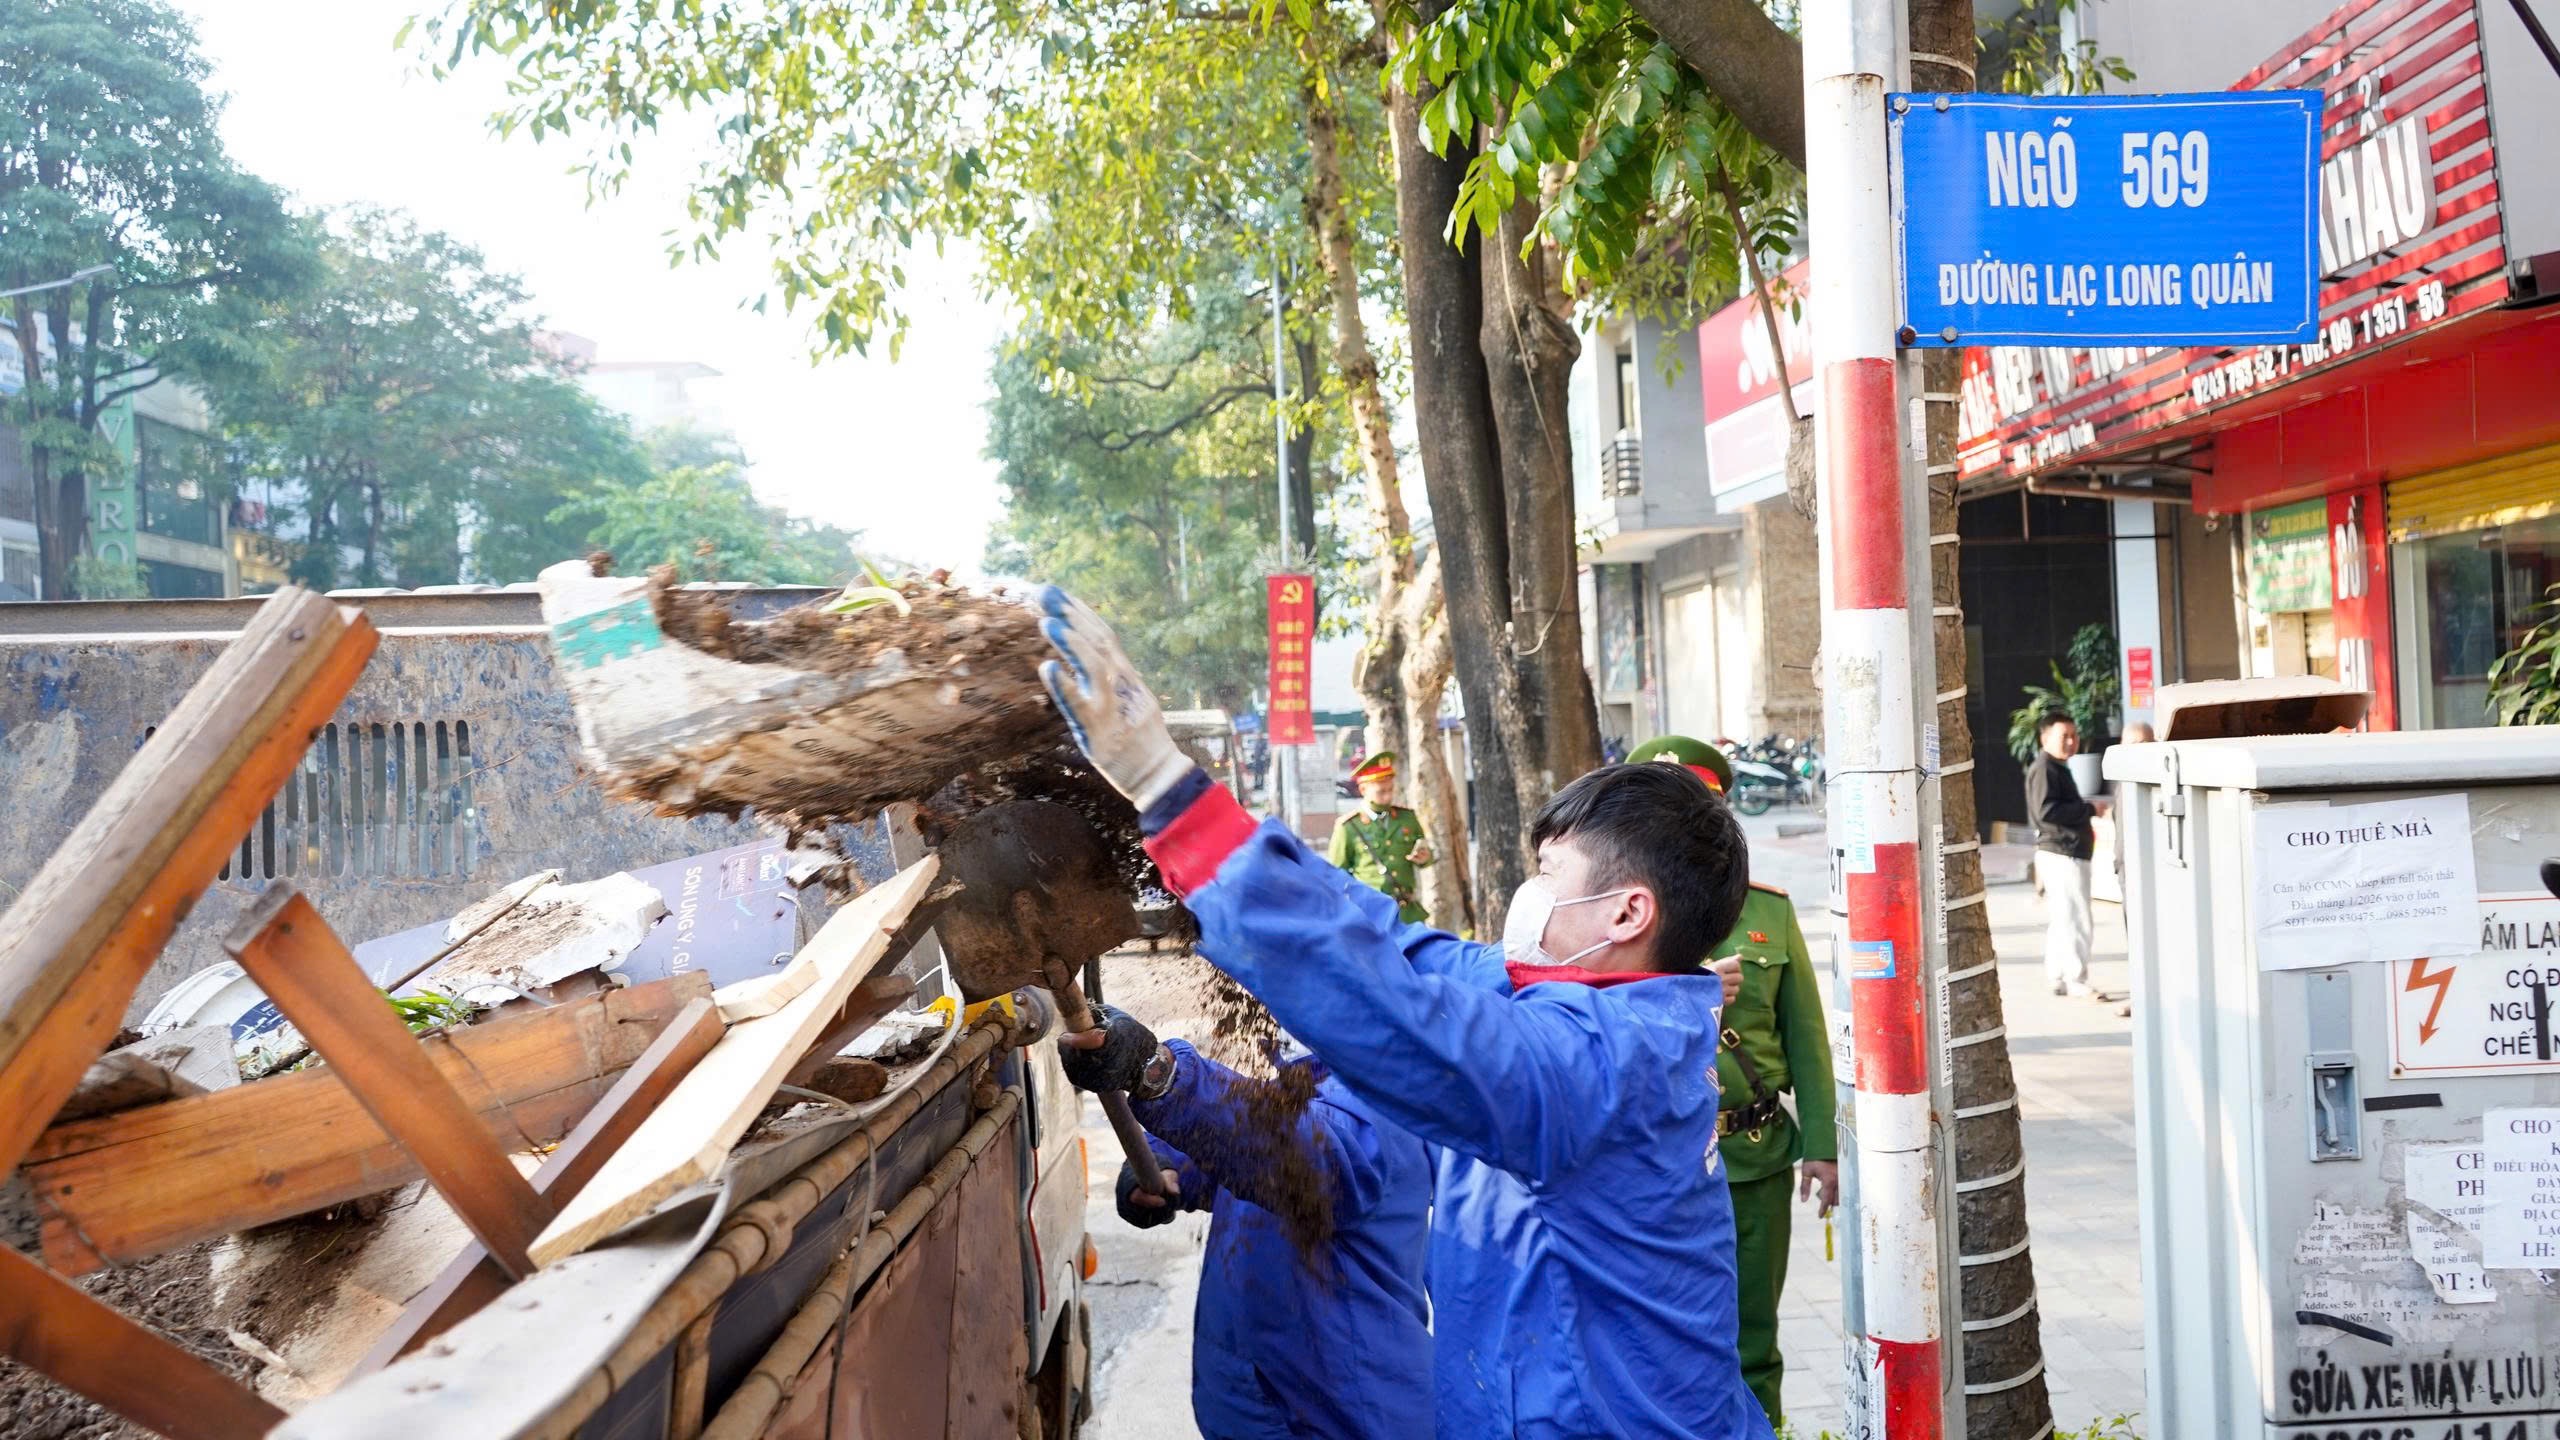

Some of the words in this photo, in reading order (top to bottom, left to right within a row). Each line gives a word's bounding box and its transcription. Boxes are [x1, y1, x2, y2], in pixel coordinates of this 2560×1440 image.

[1986, 116, 2078, 208] NGÕ
[2122, 130, 2209, 208] 569
[1939, 250, 2037, 306] ĐƯỜNG
[2046, 264, 2096, 317] LẠC
[2106, 264, 2181, 306] LONG
[2191, 252, 2273, 309] QUÂN
[2287, 831, 2330, 847] CHO
[2336, 822, 2386, 844] THUÊ
[2391, 817, 2432, 839] NHÀ
[2481, 912, 2517, 951] ẤM
[2526, 921, 2560, 956] LẠ
[2506, 963, 2538, 988] CÓ
[2484, 1028, 2540, 1056] CHẾ
[2510, 1120, 2551, 1134] CHO
[2456, 1152, 2484, 1170] CH
[2457, 1180, 2484, 1196] PH
[2523, 1210, 2548, 1223] ĐỊA
[2522, 1242, 2555, 1257] LH:
[2290, 1350, 2356, 1415] SỬA
[2362, 1364, 2403, 1409] XE
[2410, 1349, 2476, 1410] MÁY
[2488, 1351, 2546, 1404] LƯU
